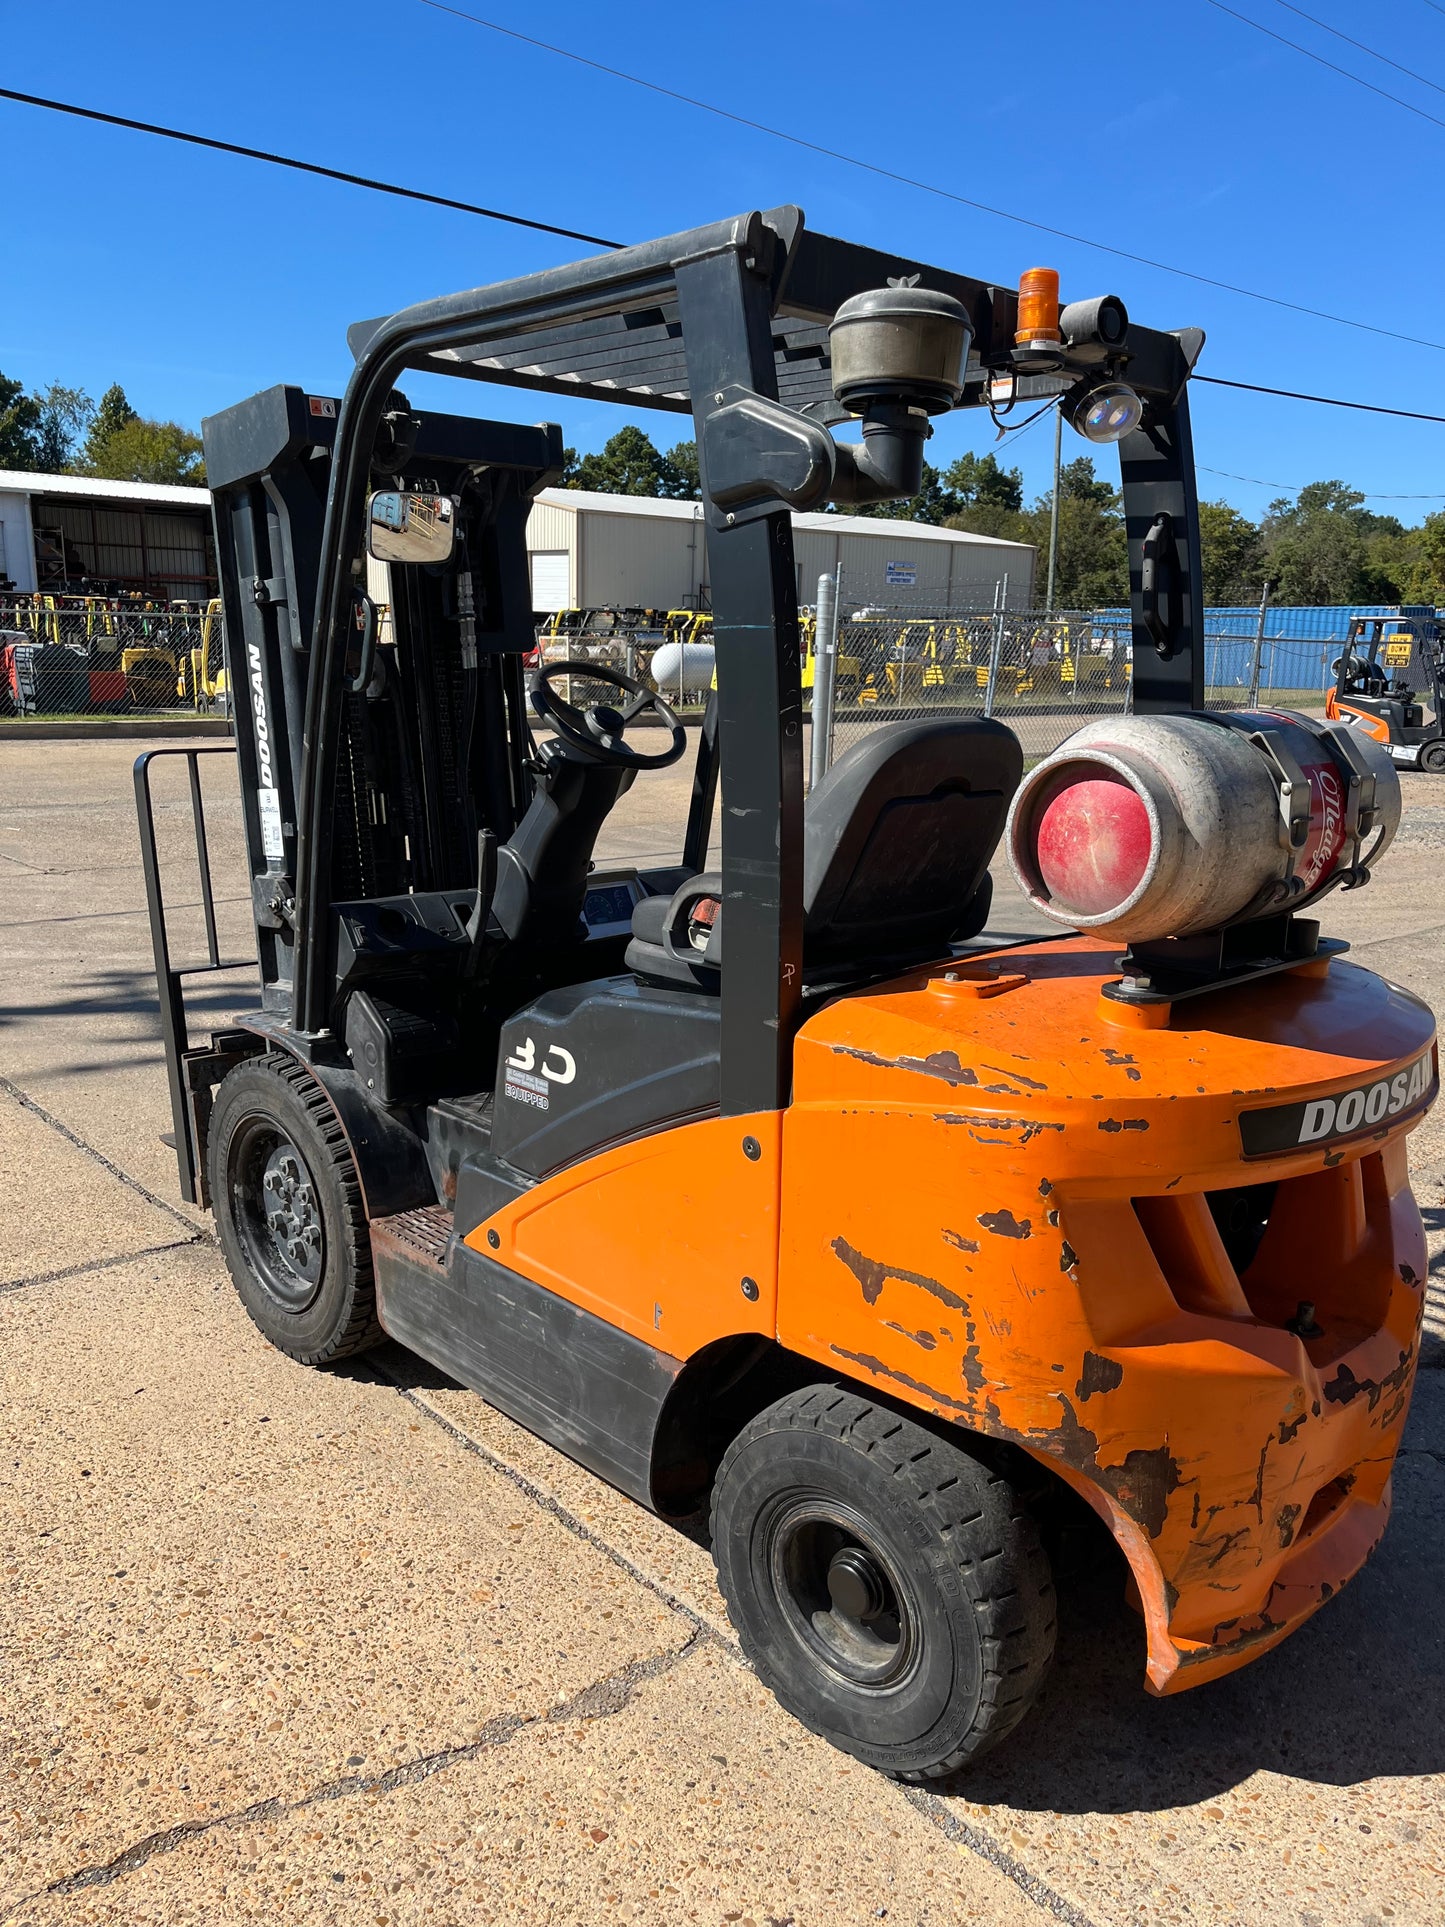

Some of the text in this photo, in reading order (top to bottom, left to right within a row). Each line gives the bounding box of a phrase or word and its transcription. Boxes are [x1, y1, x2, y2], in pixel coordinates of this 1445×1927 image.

[248, 642, 273, 789] DOOSAN
[504, 1083, 550, 1110] EQUIPPED
[1298, 1050, 1434, 1143] DOOSAN
